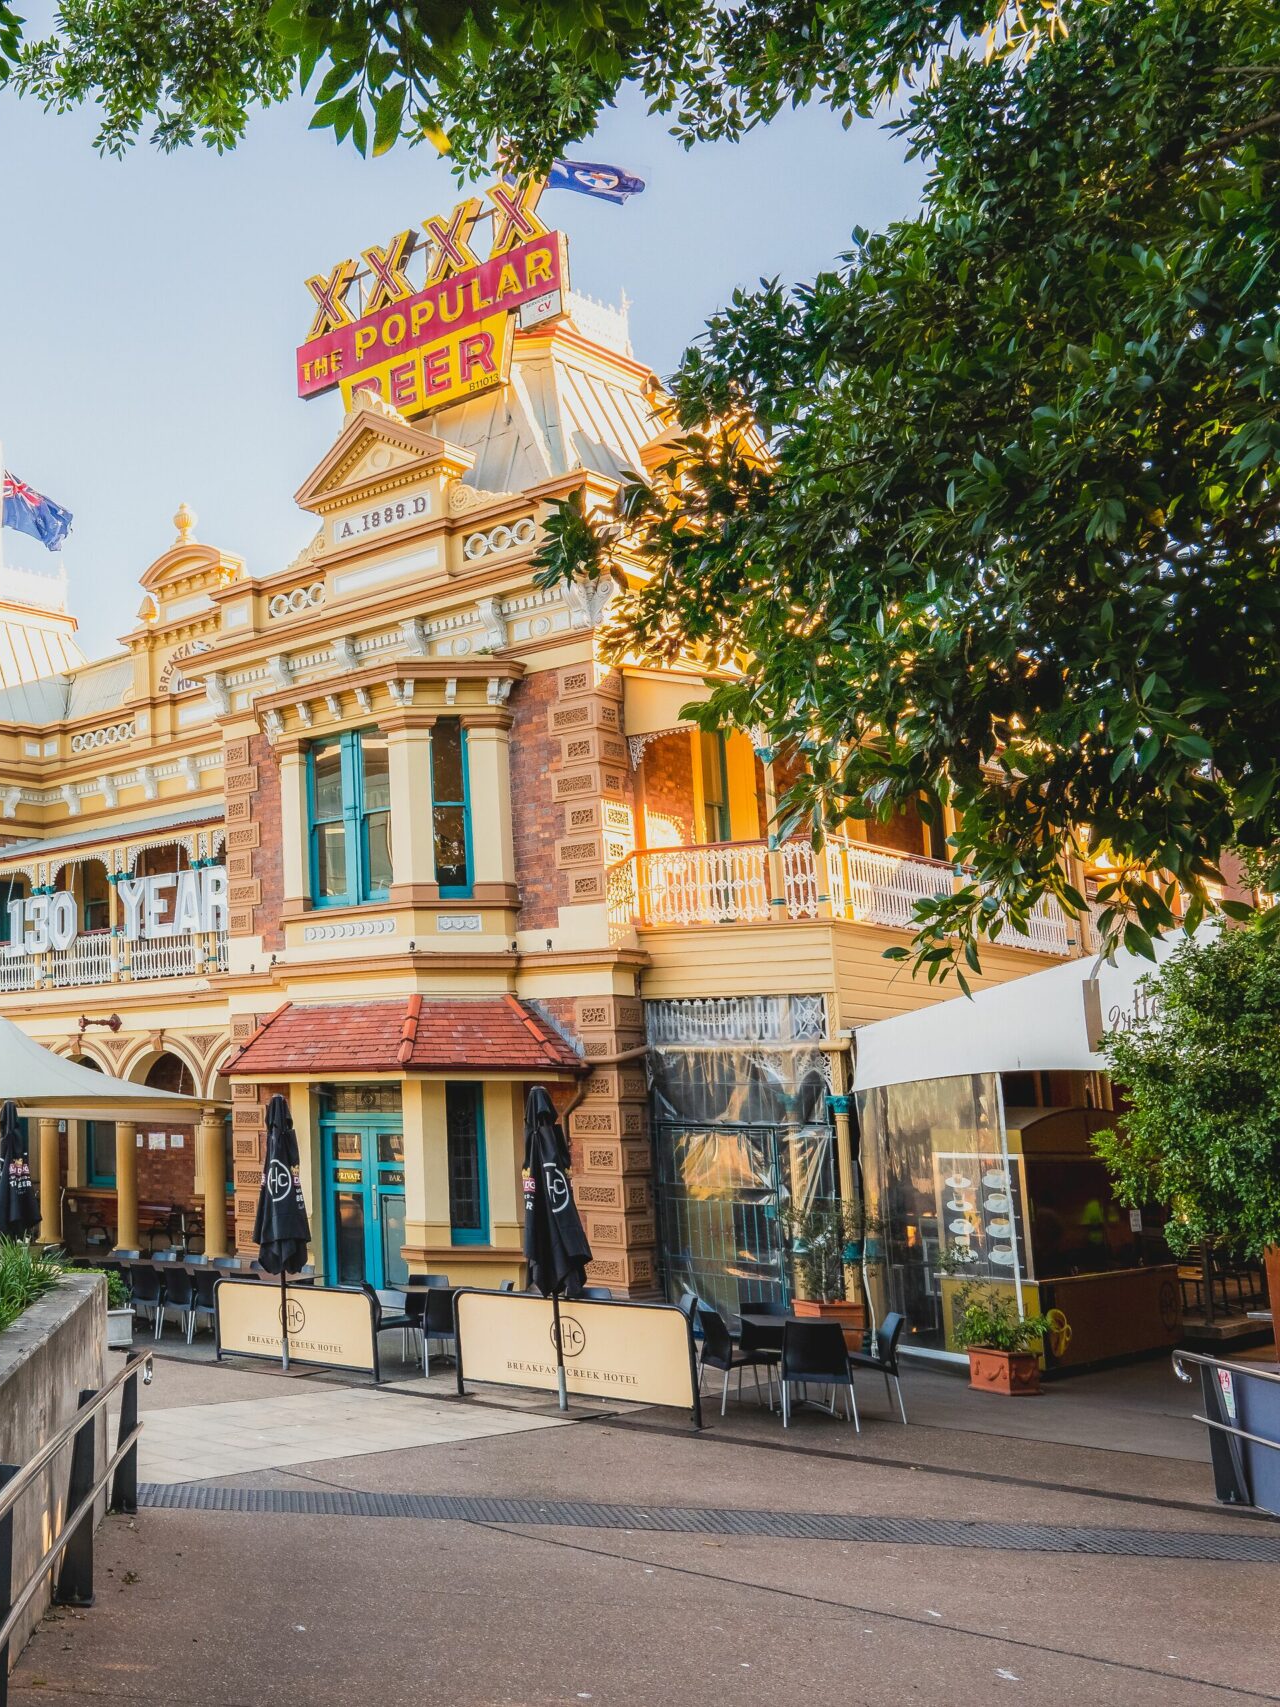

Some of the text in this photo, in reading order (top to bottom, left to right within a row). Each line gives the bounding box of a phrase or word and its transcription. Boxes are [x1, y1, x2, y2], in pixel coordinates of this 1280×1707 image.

[305, 174, 551, 343] XXXX
[301, 248, 554, 383] THE POPULAR
[538, 300, 552, 313] CV
[5, 865, 228, 957] 130 YEAR
[337, 1172, 402, 1182] PRIVATE BAR
[247, 1335, 343, 1353] BREAKFA CREEK HOTEL
[507, 1361, 639, 1384] BREAKFAS CREEK HOTEL
